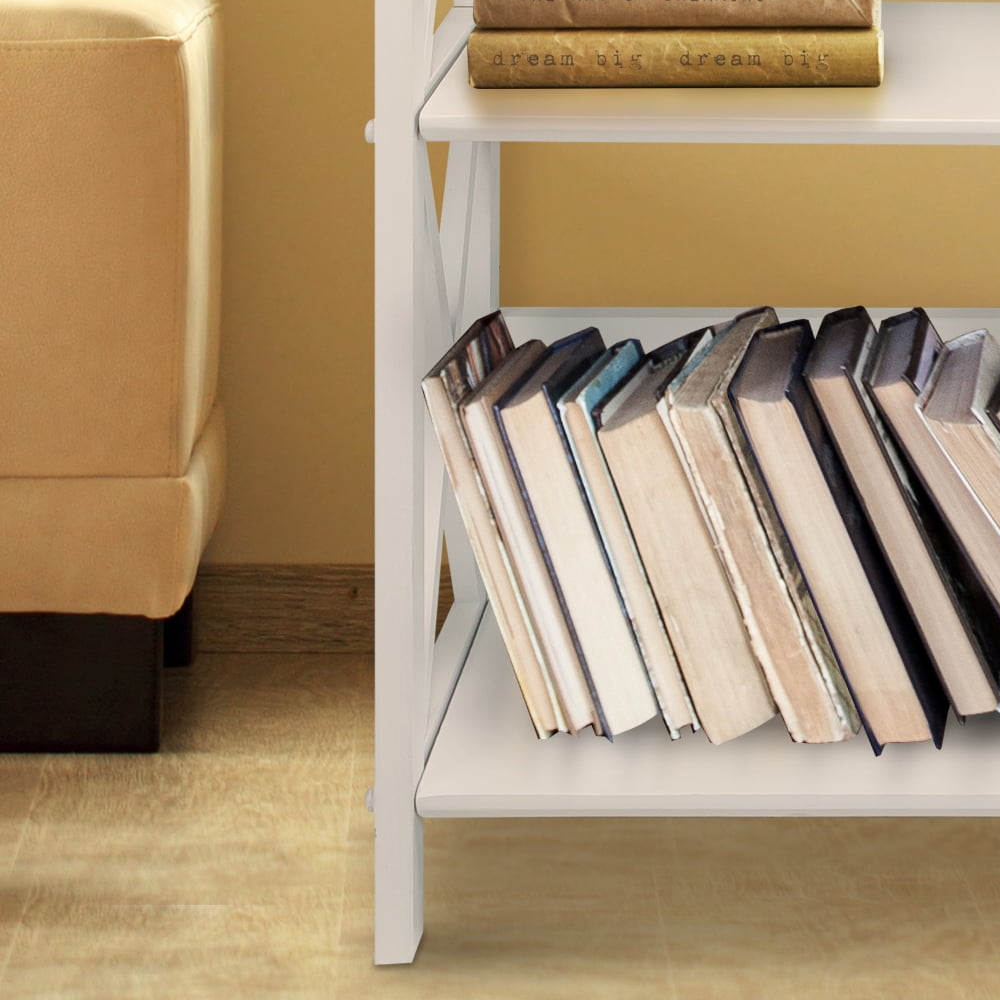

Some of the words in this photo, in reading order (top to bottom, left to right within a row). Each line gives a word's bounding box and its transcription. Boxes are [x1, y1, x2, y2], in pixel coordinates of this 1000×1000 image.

[492, 49, 575, 67] dream
[596, 49, 643, 70] big
[679, 49, 762, 67] dream
[783, 49, 830, 70] big
